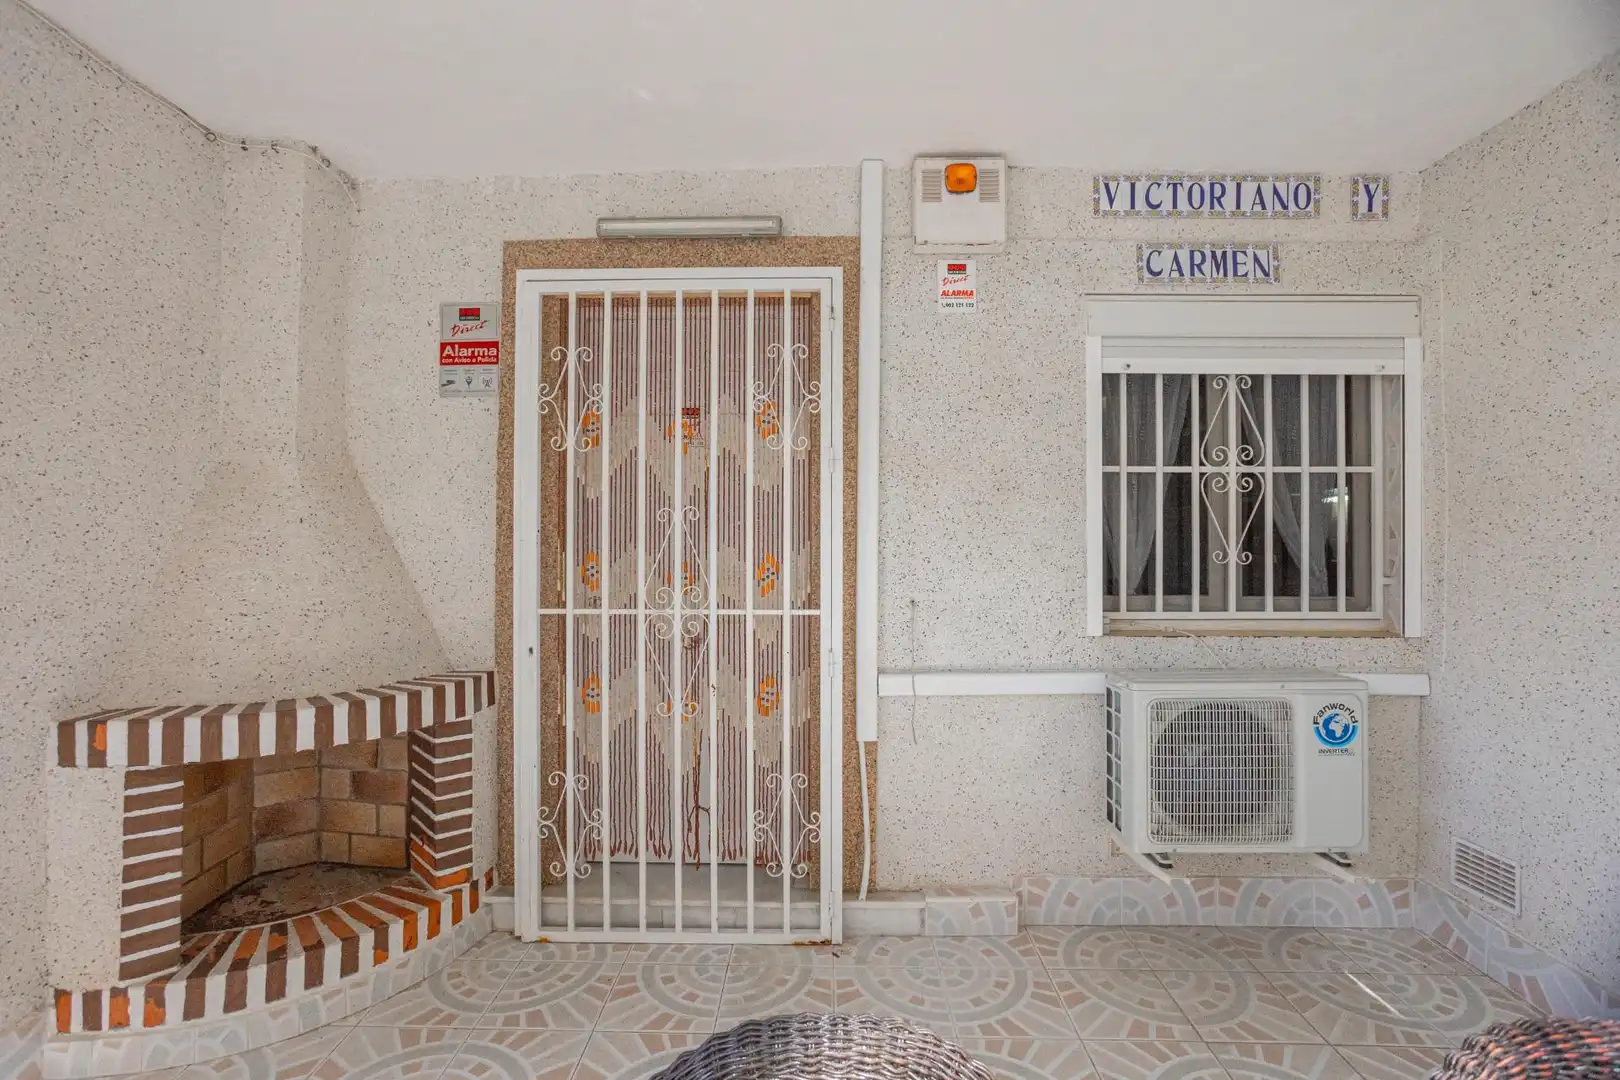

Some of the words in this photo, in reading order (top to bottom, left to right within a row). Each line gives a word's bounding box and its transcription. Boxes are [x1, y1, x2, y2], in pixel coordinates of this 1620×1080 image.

[1103, 182, 1312, 210] VICTORIANO
[1364, 184, 1380, 212] Y
[1146, 250, 1271, 277] CARMEN
[451, 320, 489, 337] Direct
[442, 344, 497, 357] Alarma
[1313, 703, 1359, 725] Fanworld
